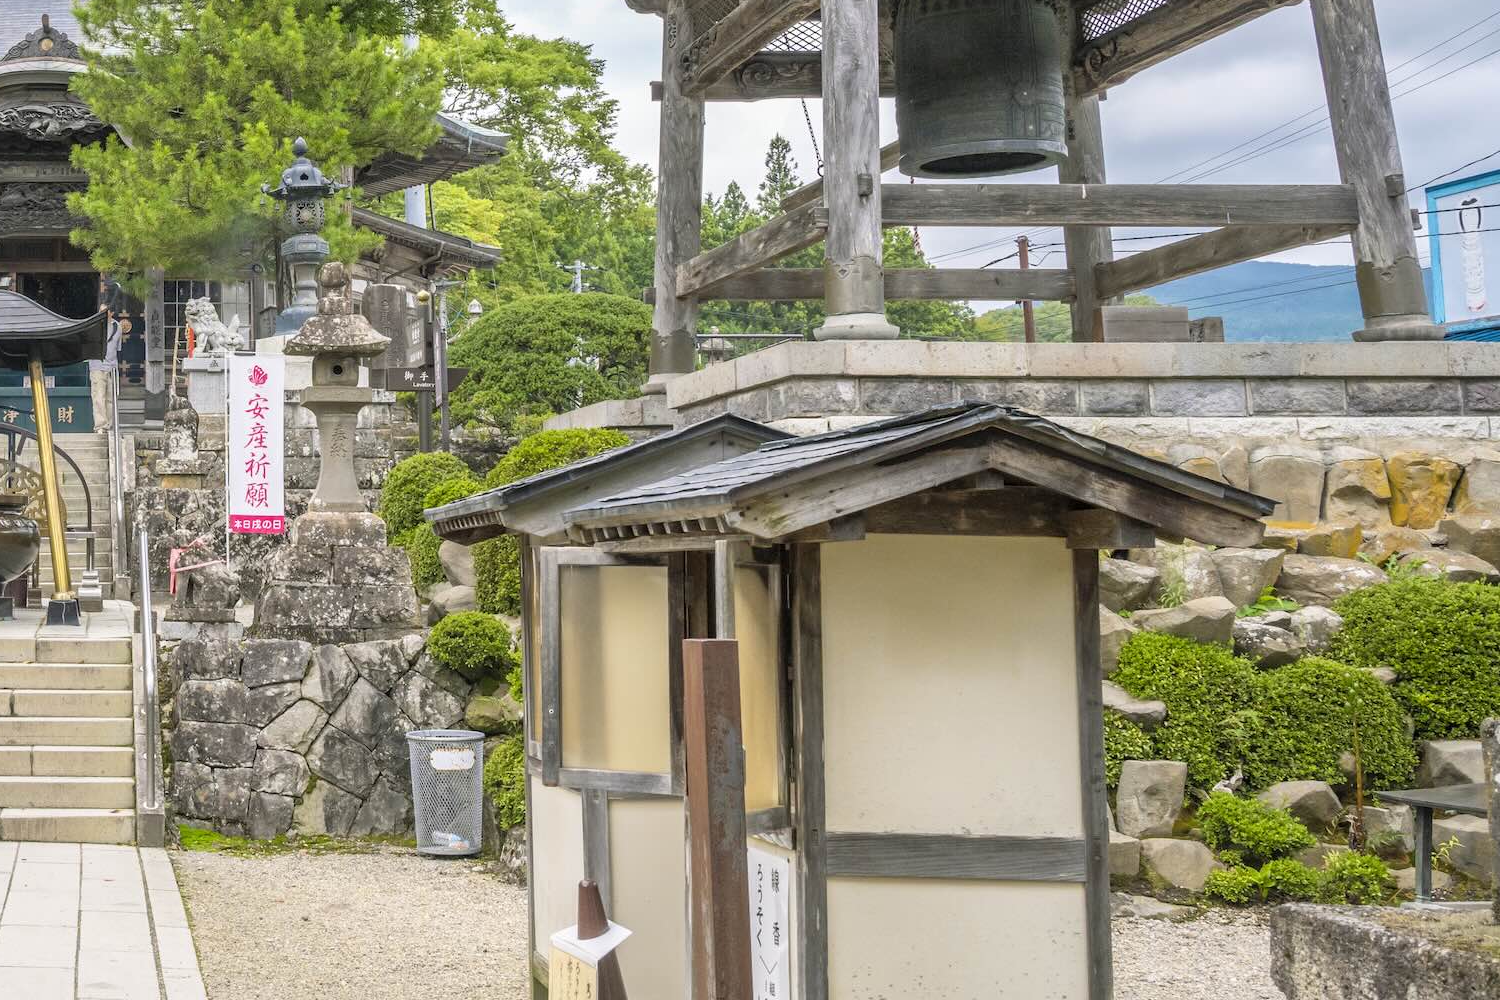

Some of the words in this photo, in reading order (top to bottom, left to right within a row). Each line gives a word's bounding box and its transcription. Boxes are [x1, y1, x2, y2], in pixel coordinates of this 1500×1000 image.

[244, 394, 271, 508] 安産祈願
[234, 519, 282, 529] 本日戌の日
[756, 863, 764, 949] ろうそく
